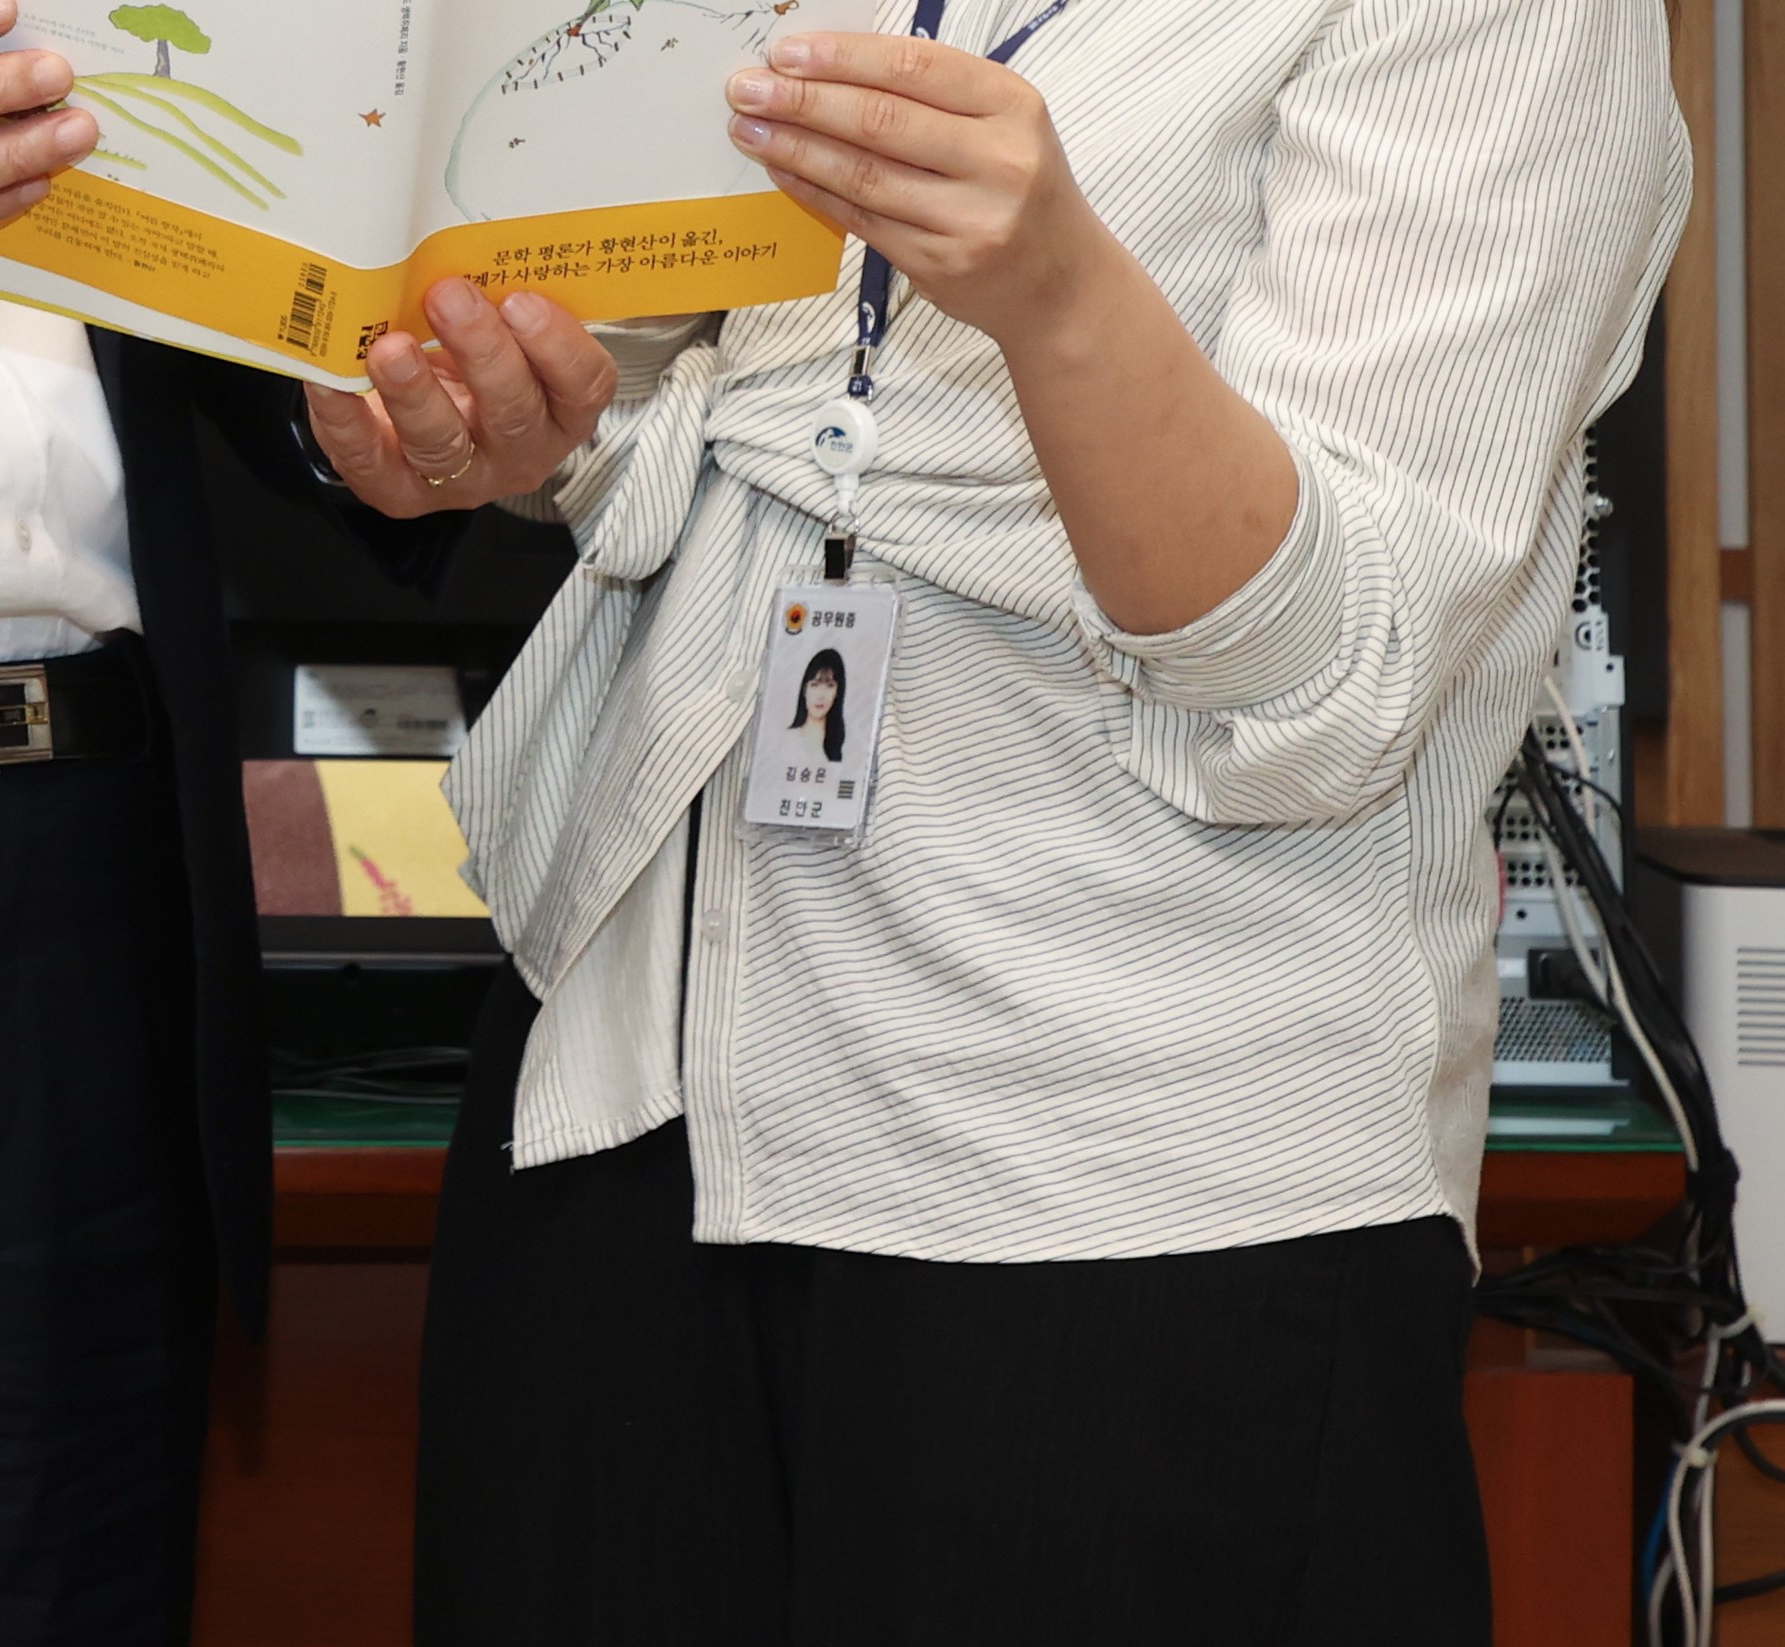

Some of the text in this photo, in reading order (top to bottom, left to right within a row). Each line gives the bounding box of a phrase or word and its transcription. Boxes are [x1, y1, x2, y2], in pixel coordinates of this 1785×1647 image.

[493, 228, 723, 266] 문학 평론가 황현산이 옮긴,
[512, 262, 590, 283] 사랑하는
[596, 256, 634, 274] 가장
[640, 249, 718, 270] 아름다운
[724, 242, 777, 262] 이야기
[812, 611, 855, 628] 공무원증
[779, 799, 822, 818] 진안군
